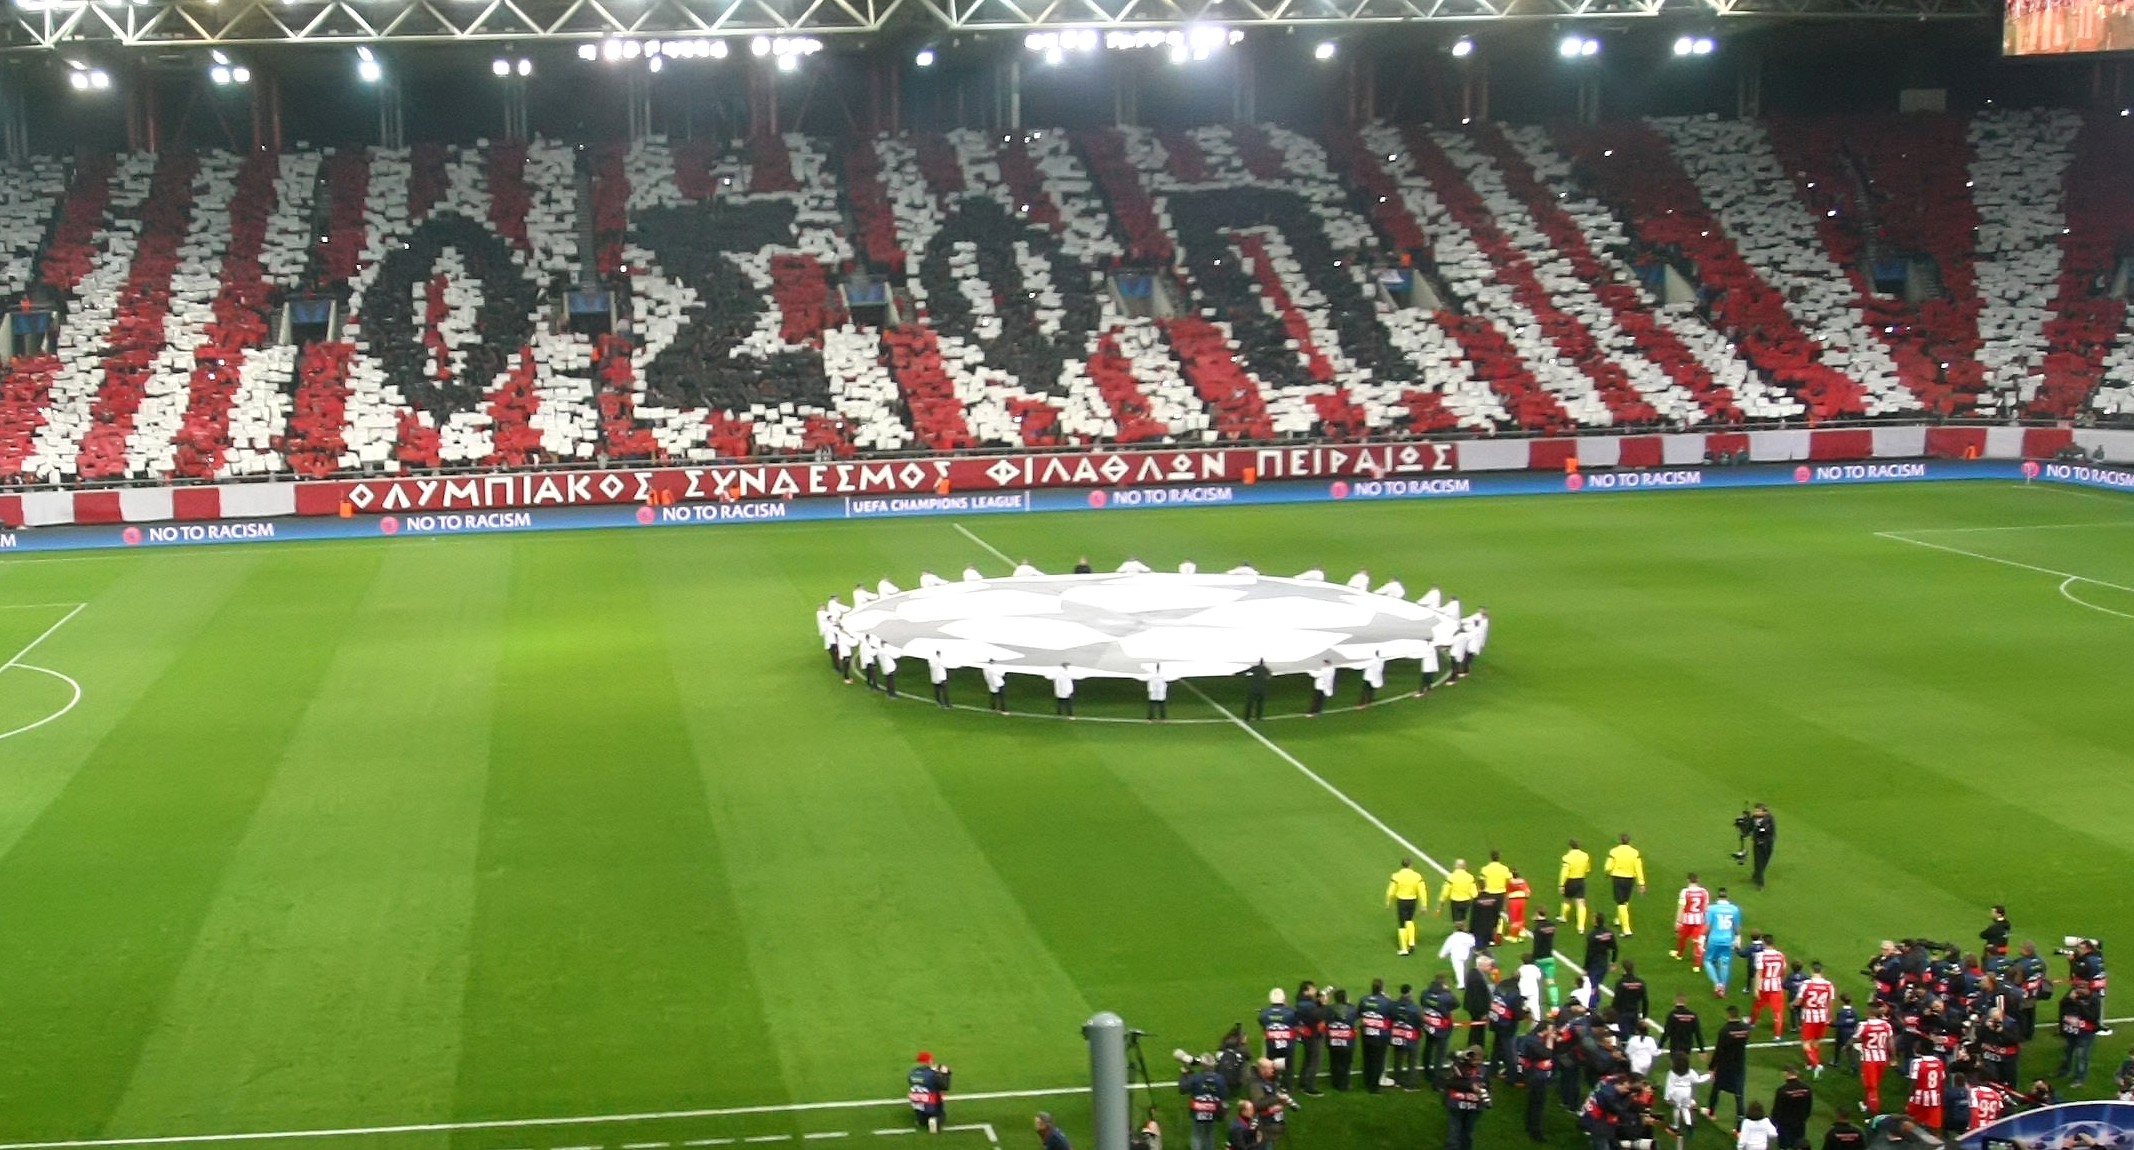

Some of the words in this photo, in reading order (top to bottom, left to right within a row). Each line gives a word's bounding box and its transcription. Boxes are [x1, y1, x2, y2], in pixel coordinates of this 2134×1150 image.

[349, 472, 652, 510] ΟΛΥΜΠΙΑΚΟΣ
[684, 461, 951, 498] ΣΥΝΔΕΣΜΟΣ
[986, 452, 1225, 486] ΦΙΛΑΘΛΩΝ
[1257, 444, 1452, 478] ΠΕΙΡΑΙΩΣ
[1589, 474, 1616, 488] NO
[1618, 473, 1639, 487] TO
[1641, 471, 1701, 486] RACISM
[1817, 466, 1843, 480] NO
[1845, 465, 1865, 479] TO
[1868, 463, 1925, 478] RACISM
[2046, 464, 2070, 478] NO
[2072, 466, 2090, 481] TO
[2091, 469, 2134, 486] RACISM
[1113, 489, 1141, 504] NO
[1144, 489, 1167, 503] TO
[1170, 487, 1232, 502] RACISM
[1354, 482, 1382, 496] NO
[1384, 480, 1406, 495] TO
[1409, 478, 1470, 494] RACISM
[663, 505, 691, 521] NO
[693, 505, 717, 519] TO
[720, 503, 785, 519] RACISM
[853, 497, 889, 513] UEFA
[891, 495, 967, 512] CHAMPIONS
[971, 493, 1022, 509] LEAGUE
[408, 517, 435, 531] NO
[438, 515, 462, 529] TO
[465, 512, 531, 528] RACISM
[150, 527, 177, 542] NO
[180, 525, 205, 540] TO
[208, 523, 274, 539] RACISM
[1691, 898, 1701, 912] 2
[1717, 914, 1733, 930] 16
[1766, 962, 1781, 977] 17
[1807, 991, 1828, 1007] 24
[1867, 1032, 1888, 1049] 20
[1928, 1070, 1938, 1088] 8
[1978, 1100, 1998, 1118] 99
